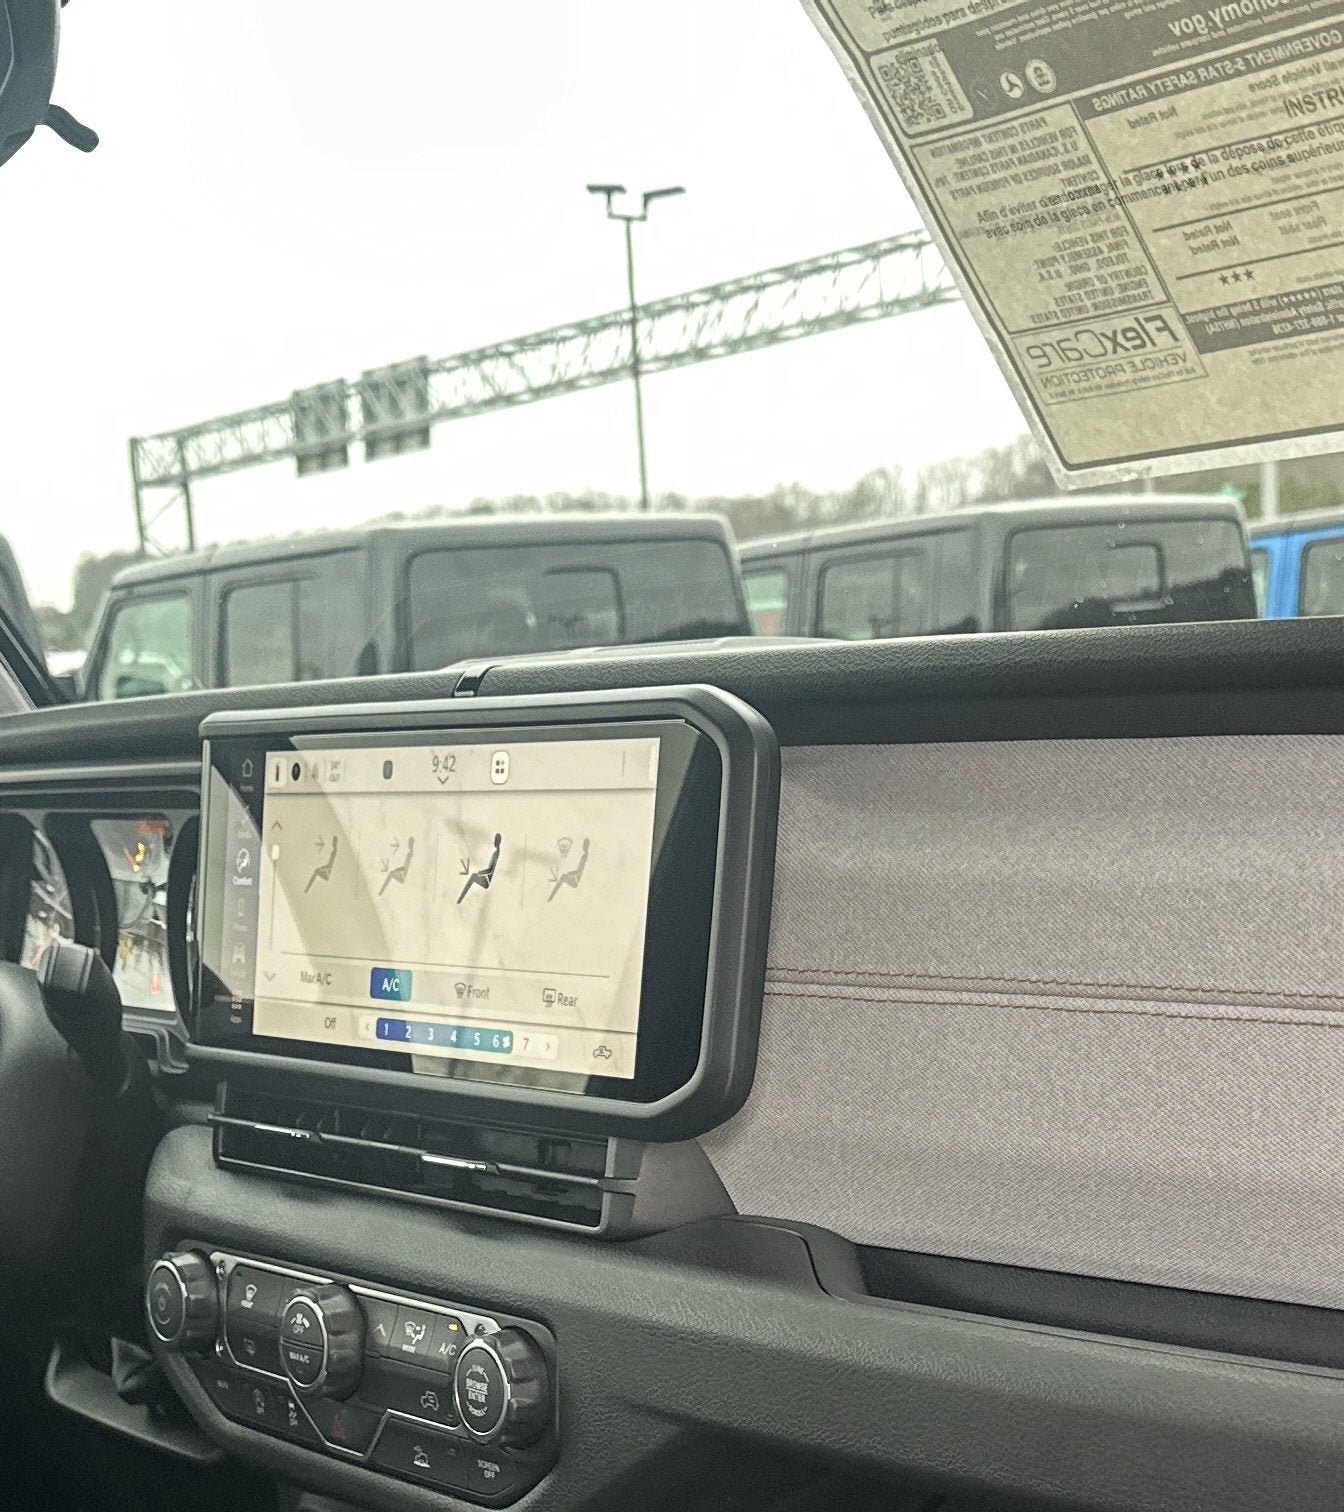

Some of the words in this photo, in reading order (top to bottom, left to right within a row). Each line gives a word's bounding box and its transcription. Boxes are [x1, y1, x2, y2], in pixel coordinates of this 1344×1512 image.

[432, 755, 457, 776] 9:42
[382, 978, 400, 992] A/C
[467, 985, 490, 1000] Front
[557, 993, 577, 1007] Rear
[325, 1018, 336, 1030] Off
[384, 1023, 389, 1036] 1
[405, 1026, 412, 1039] 2
[428, 1028, 434, 1041] 3
[450, 1030, 457, 1043] 4
[474, 1033, 480, 1046] 5
[492, 1035, 499, 1048] 6
[523, 1038, 529, 1051] 7
[439, 1342, 456, 1356] A/C
